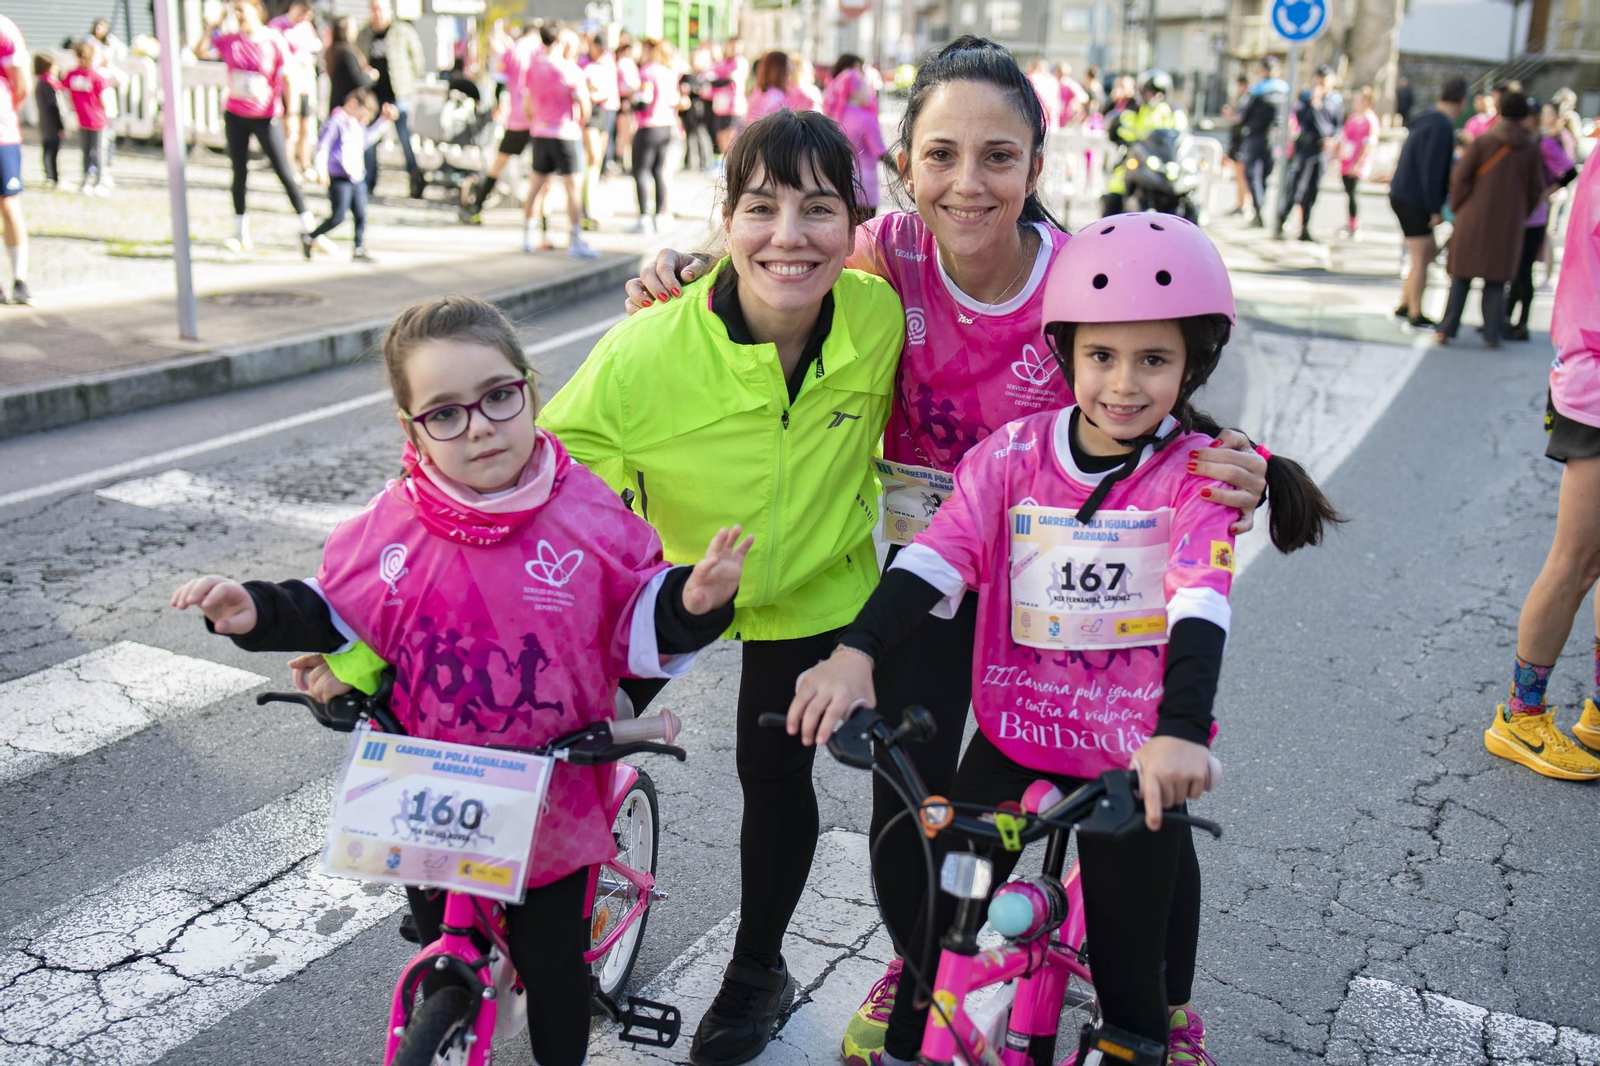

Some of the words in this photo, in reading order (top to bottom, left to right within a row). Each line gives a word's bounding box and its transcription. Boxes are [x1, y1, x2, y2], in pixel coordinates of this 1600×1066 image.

[875, 462, 894, 476] III
[897, 467, 933, 480] CARREIRA
[934, 474, 954, 485] POLA
[1015, 514, 1031, 535] III
[1038, 515, 1079, 528] CARREIRA
[1082, 518, 1102, 529] OLA
[1105, 518, 1157, 529] IGUALDADE
[1061, 562, 1126, 592] 167
[982, 665, 1017, 687] III
[1015, 670, 1072, 696] Carreira
[1072, 680, 1103, 707] pola
[1016, 696, 1024, 707] e
[1068, 708, 1080, 719] a
[1085, 704, 1144, 725] violencia
[362, 741, 388, 761] III
[395, 744, 442, 760] CARREIRA
[444, 751, 470, 764] POLA
[473, 755, 528, 773] IGUALDADE
[409, 791, 484, 830] 160
